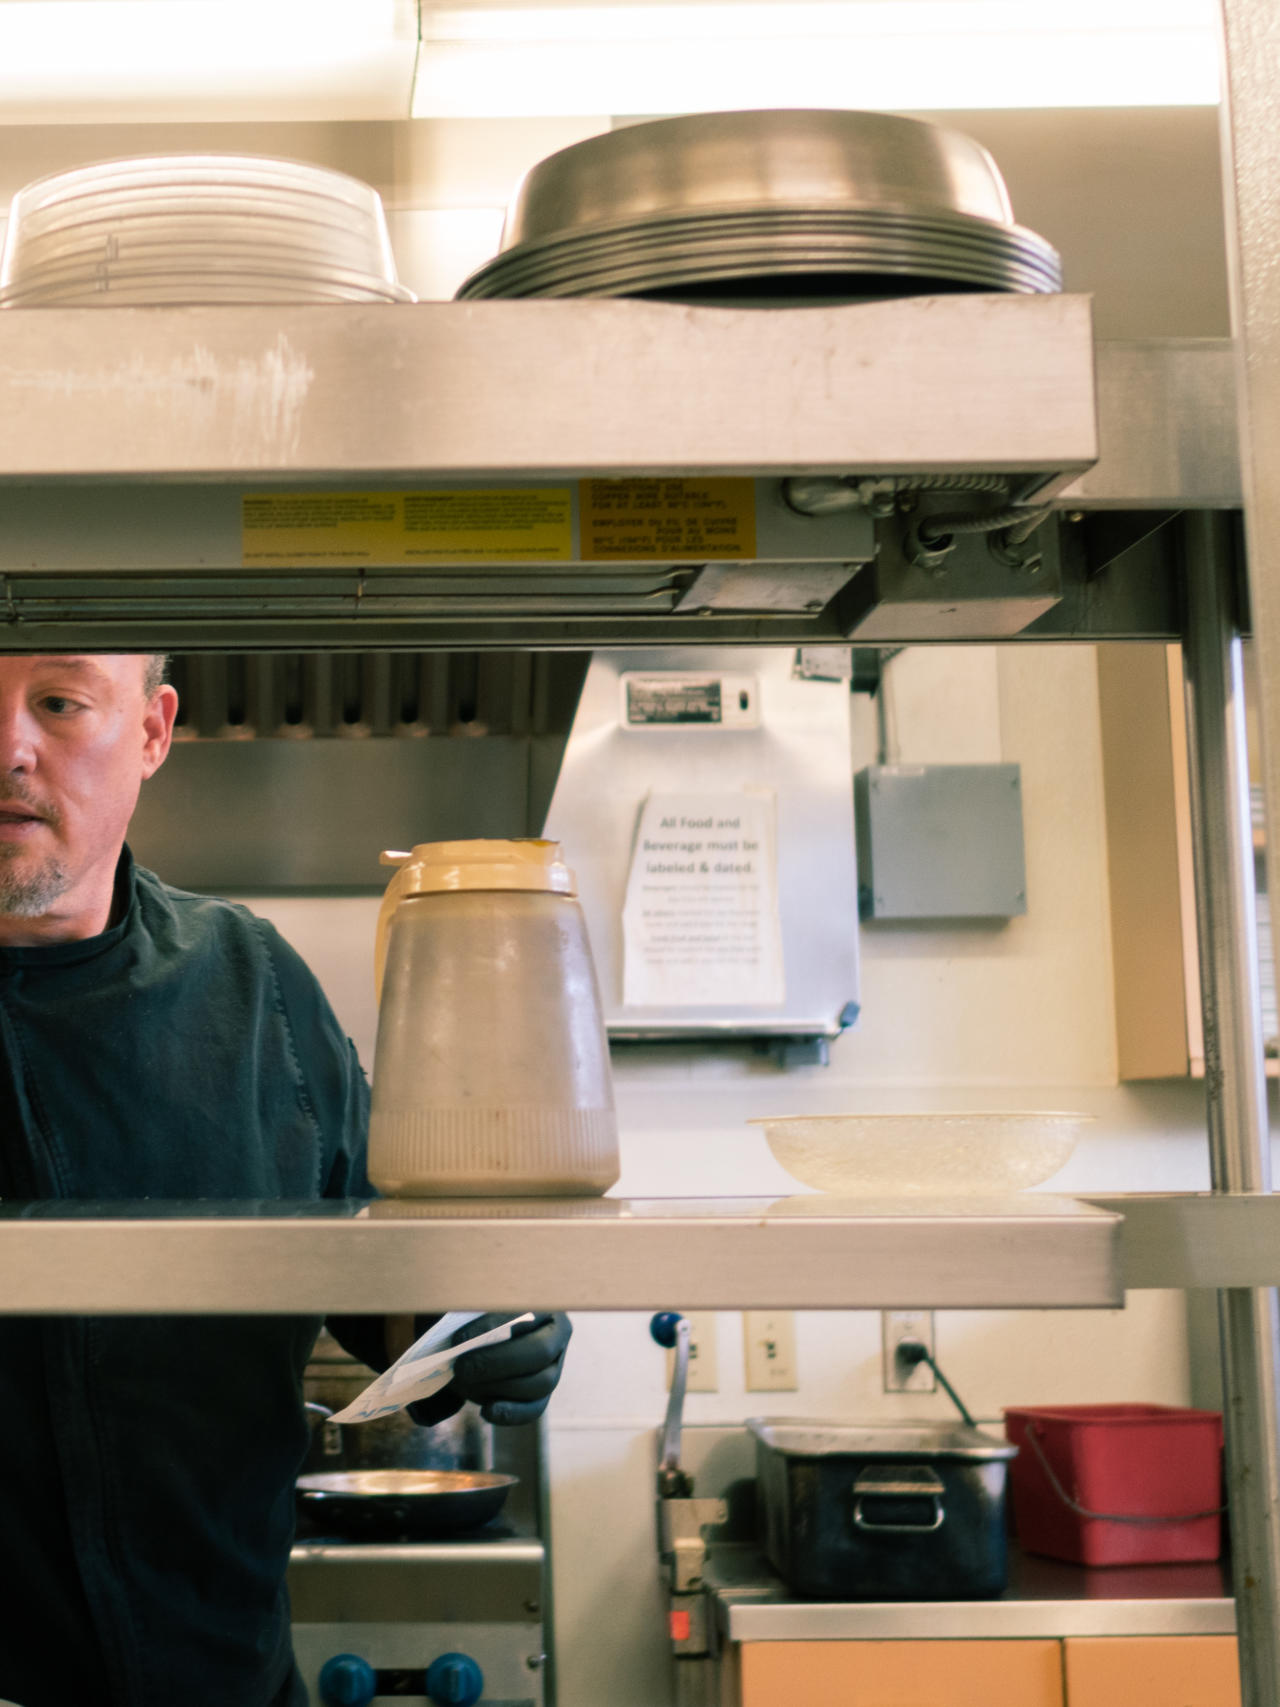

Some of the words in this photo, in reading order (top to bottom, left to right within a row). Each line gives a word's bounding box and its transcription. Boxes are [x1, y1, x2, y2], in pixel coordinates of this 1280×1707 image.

[660, 816, 677, 830] All
[681, 816, 713, 830] Food
[717, 816, 740, 830] and
[643, 839, 703, 855] Beverage
[707, 840, 738, 852] must
[742, 839, 758, 852] be
[645, 860, 695, 874] labeled
[699, 860, 710, 874] &
